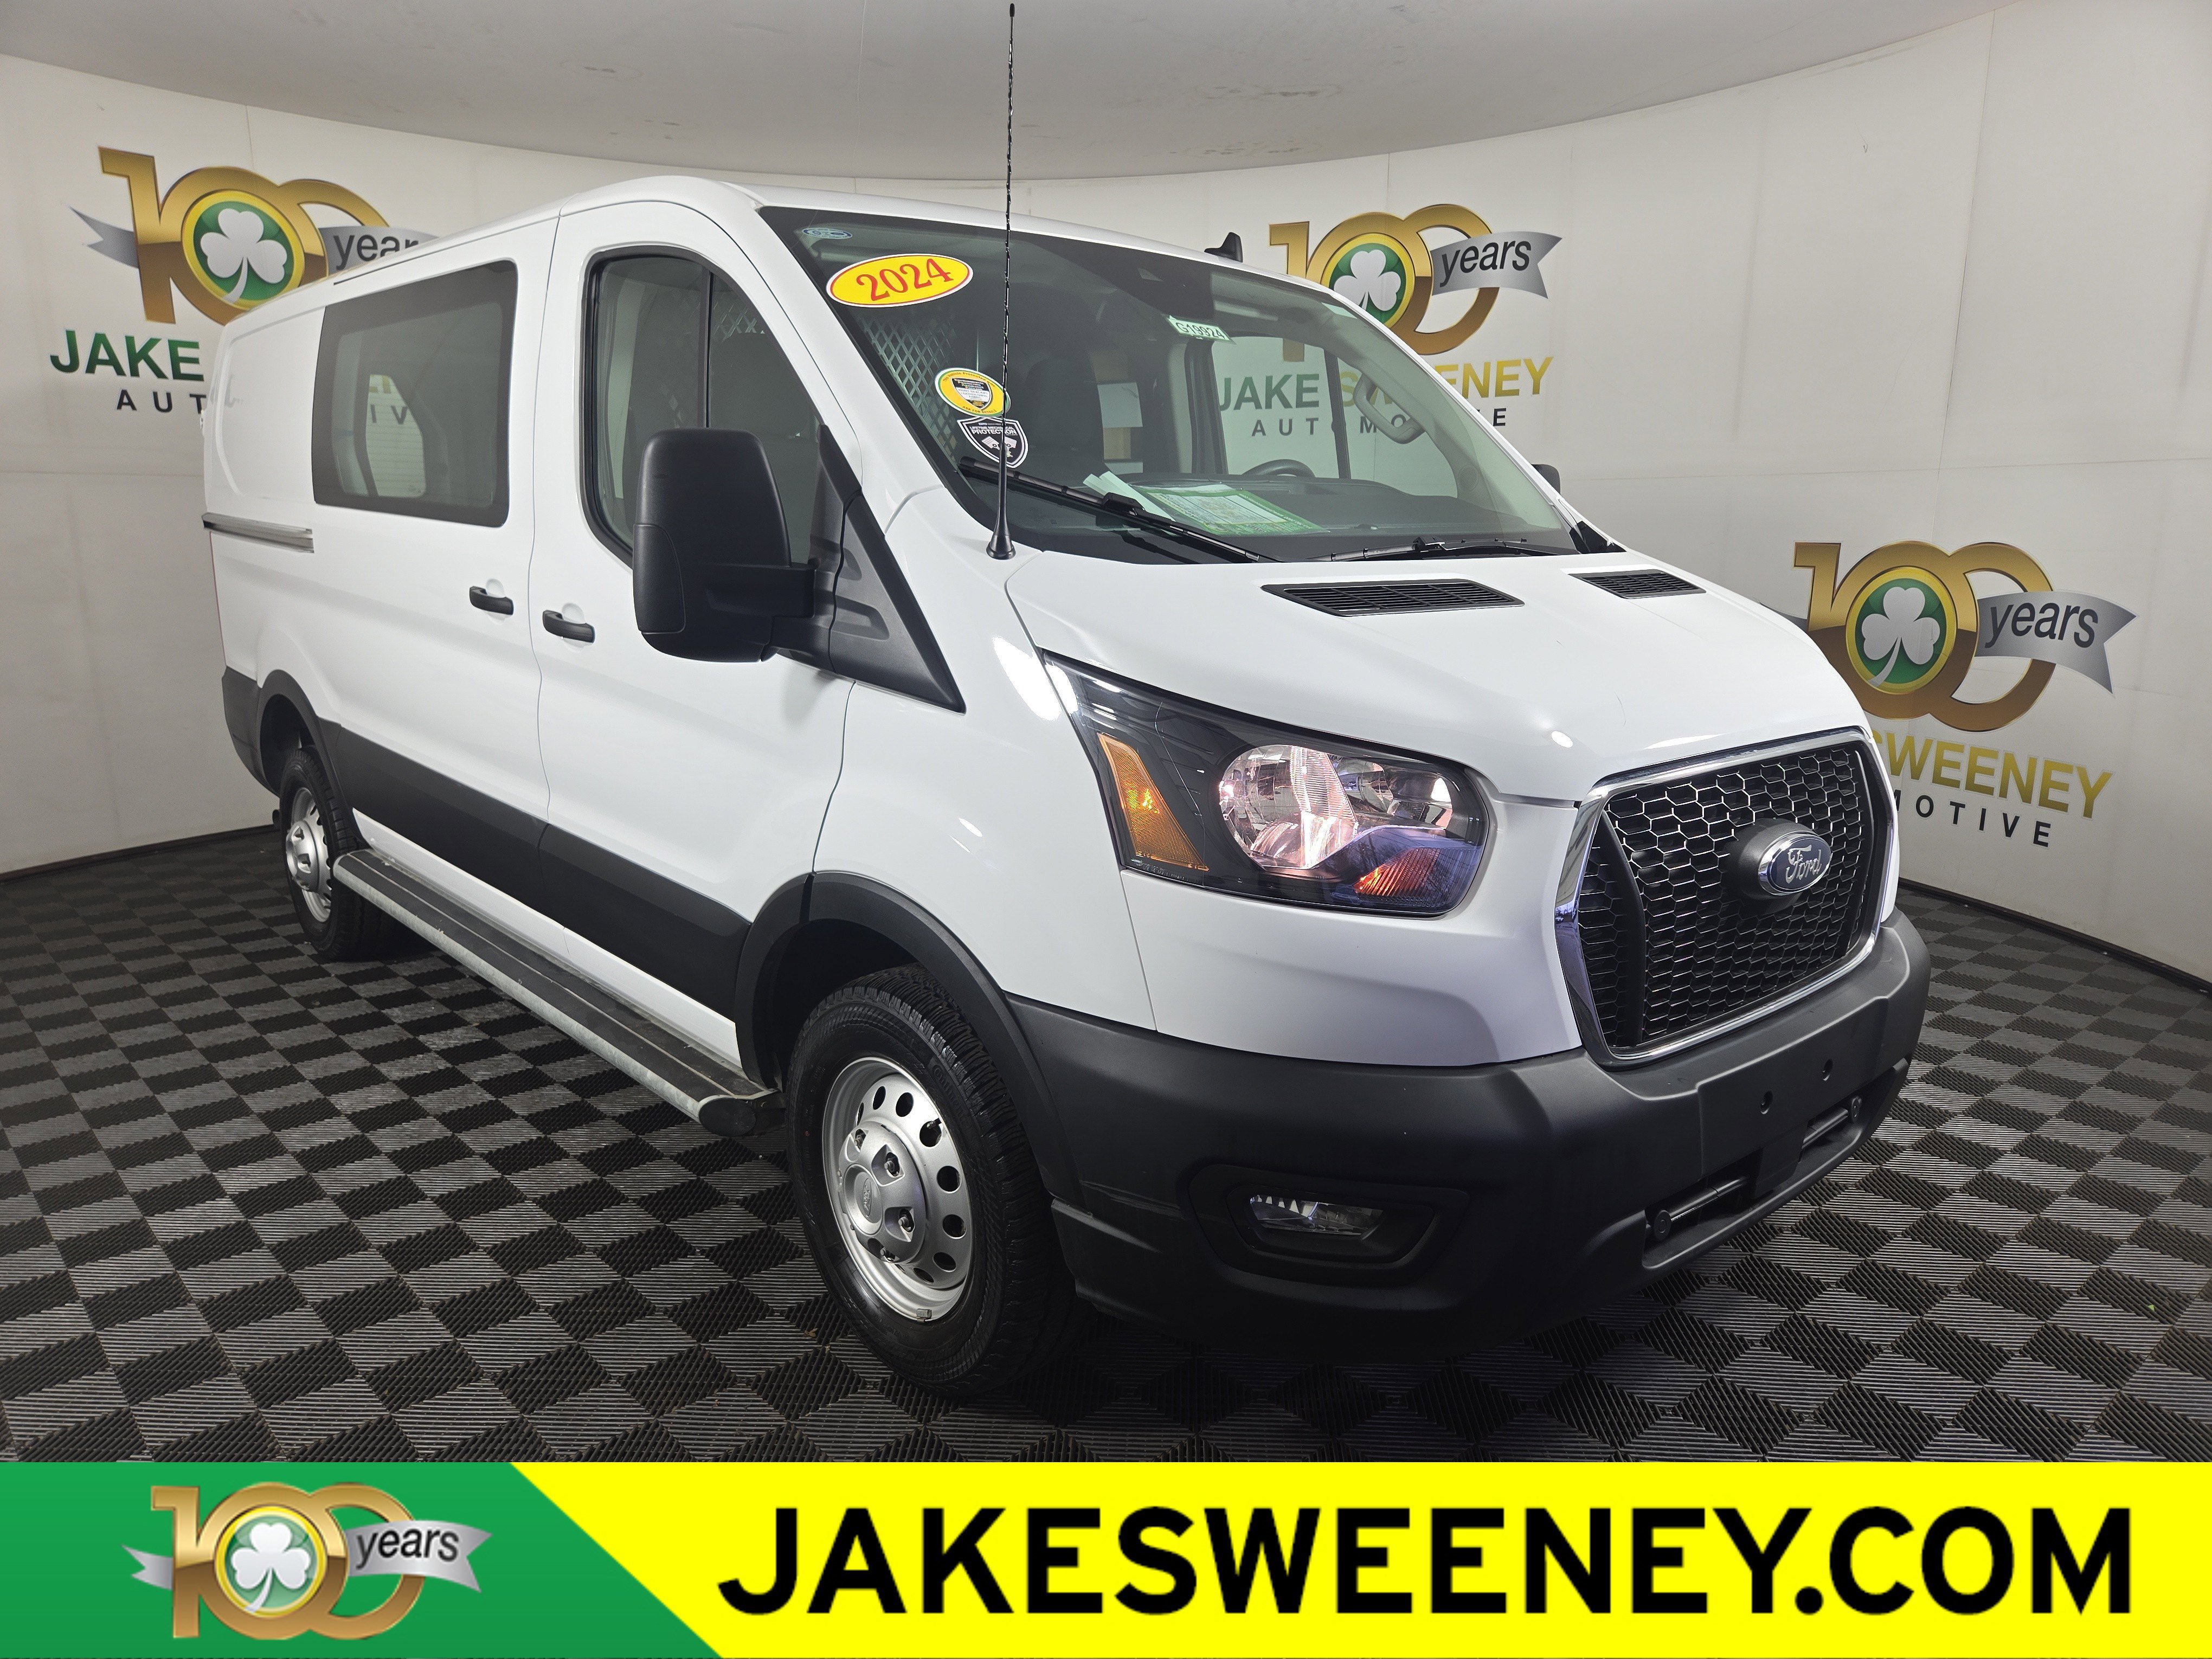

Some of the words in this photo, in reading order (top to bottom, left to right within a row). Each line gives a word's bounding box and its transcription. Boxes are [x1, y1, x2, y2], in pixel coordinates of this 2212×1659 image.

[856, 258, 954, 301] 2024
[1439, 236, 1532, 288] years
[1175, 322, 1226, 340] G19924
[50, 330, 204, 381] JAKE
[1219, 373, 1320, 411] JAKE
[1793, 541, 2055, 732] 100
[1984, 602, 2099, 648] years
[1872, 729, 2114, 820] WEENEY
[1785, 844, 1823, 884] Ford
